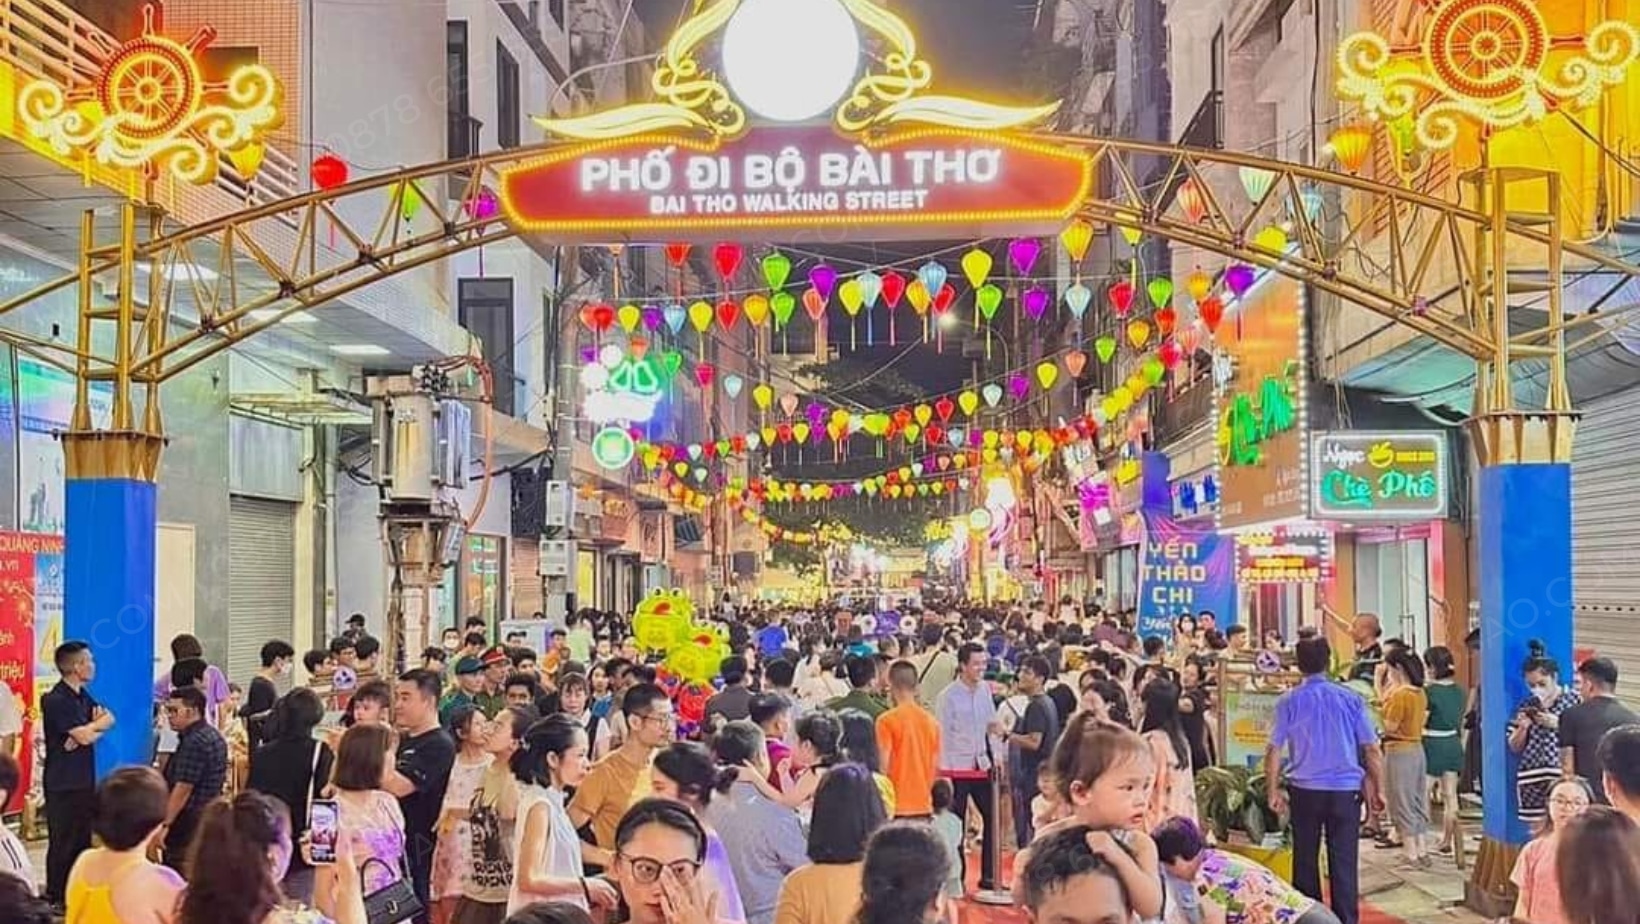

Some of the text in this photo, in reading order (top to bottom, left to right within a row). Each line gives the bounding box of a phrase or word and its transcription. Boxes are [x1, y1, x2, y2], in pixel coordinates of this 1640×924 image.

[580, 144, 1002, 194] PHỐ ĐI BỘ BÀI THƠ
[650, 189, 929, 214] BAI THO WALKING STREET
[1320, 470, 1373, 509] Chè
[1377, 469, 1437, 500] Phố
[1141, 560, 1207, 582] THẢO
[1151, 585, 1194, 605] CHI
